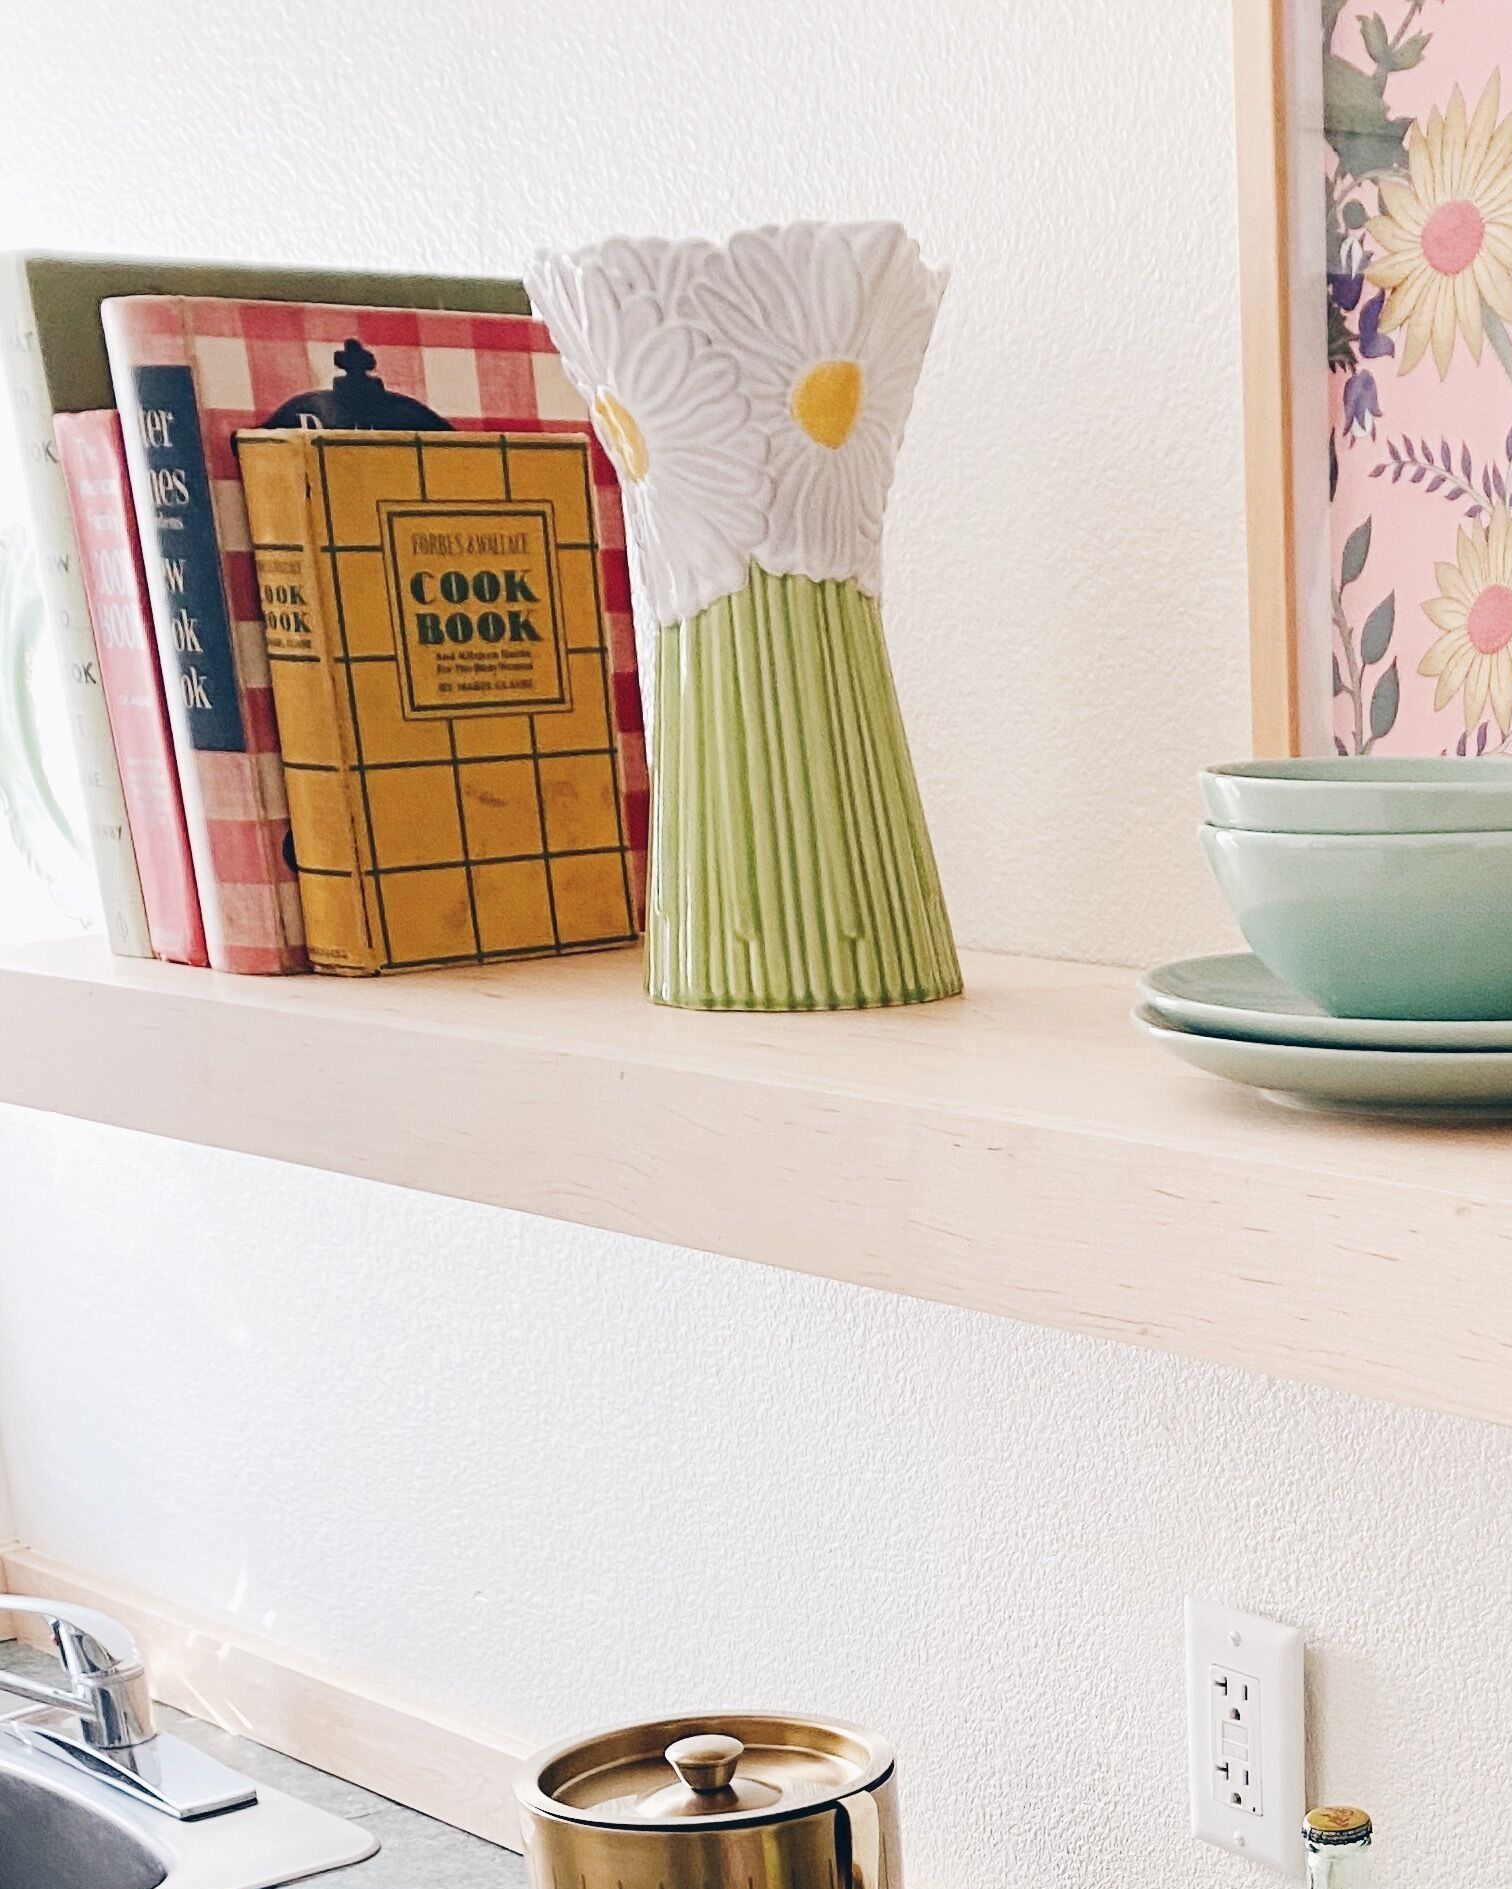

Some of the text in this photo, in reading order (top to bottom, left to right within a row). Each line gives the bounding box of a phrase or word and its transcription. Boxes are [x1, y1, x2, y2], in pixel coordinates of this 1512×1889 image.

[411, 532, 463, 556] FORBES
[264, 585, 307, 606] OOK
[410, 569, 541, 605] COOK
[171, 608, 204, 652] ok
[268, 611, 312, 633] OOK
[415, 608, 544, 645] BOOK
[181, 665, 213, 710] ok
